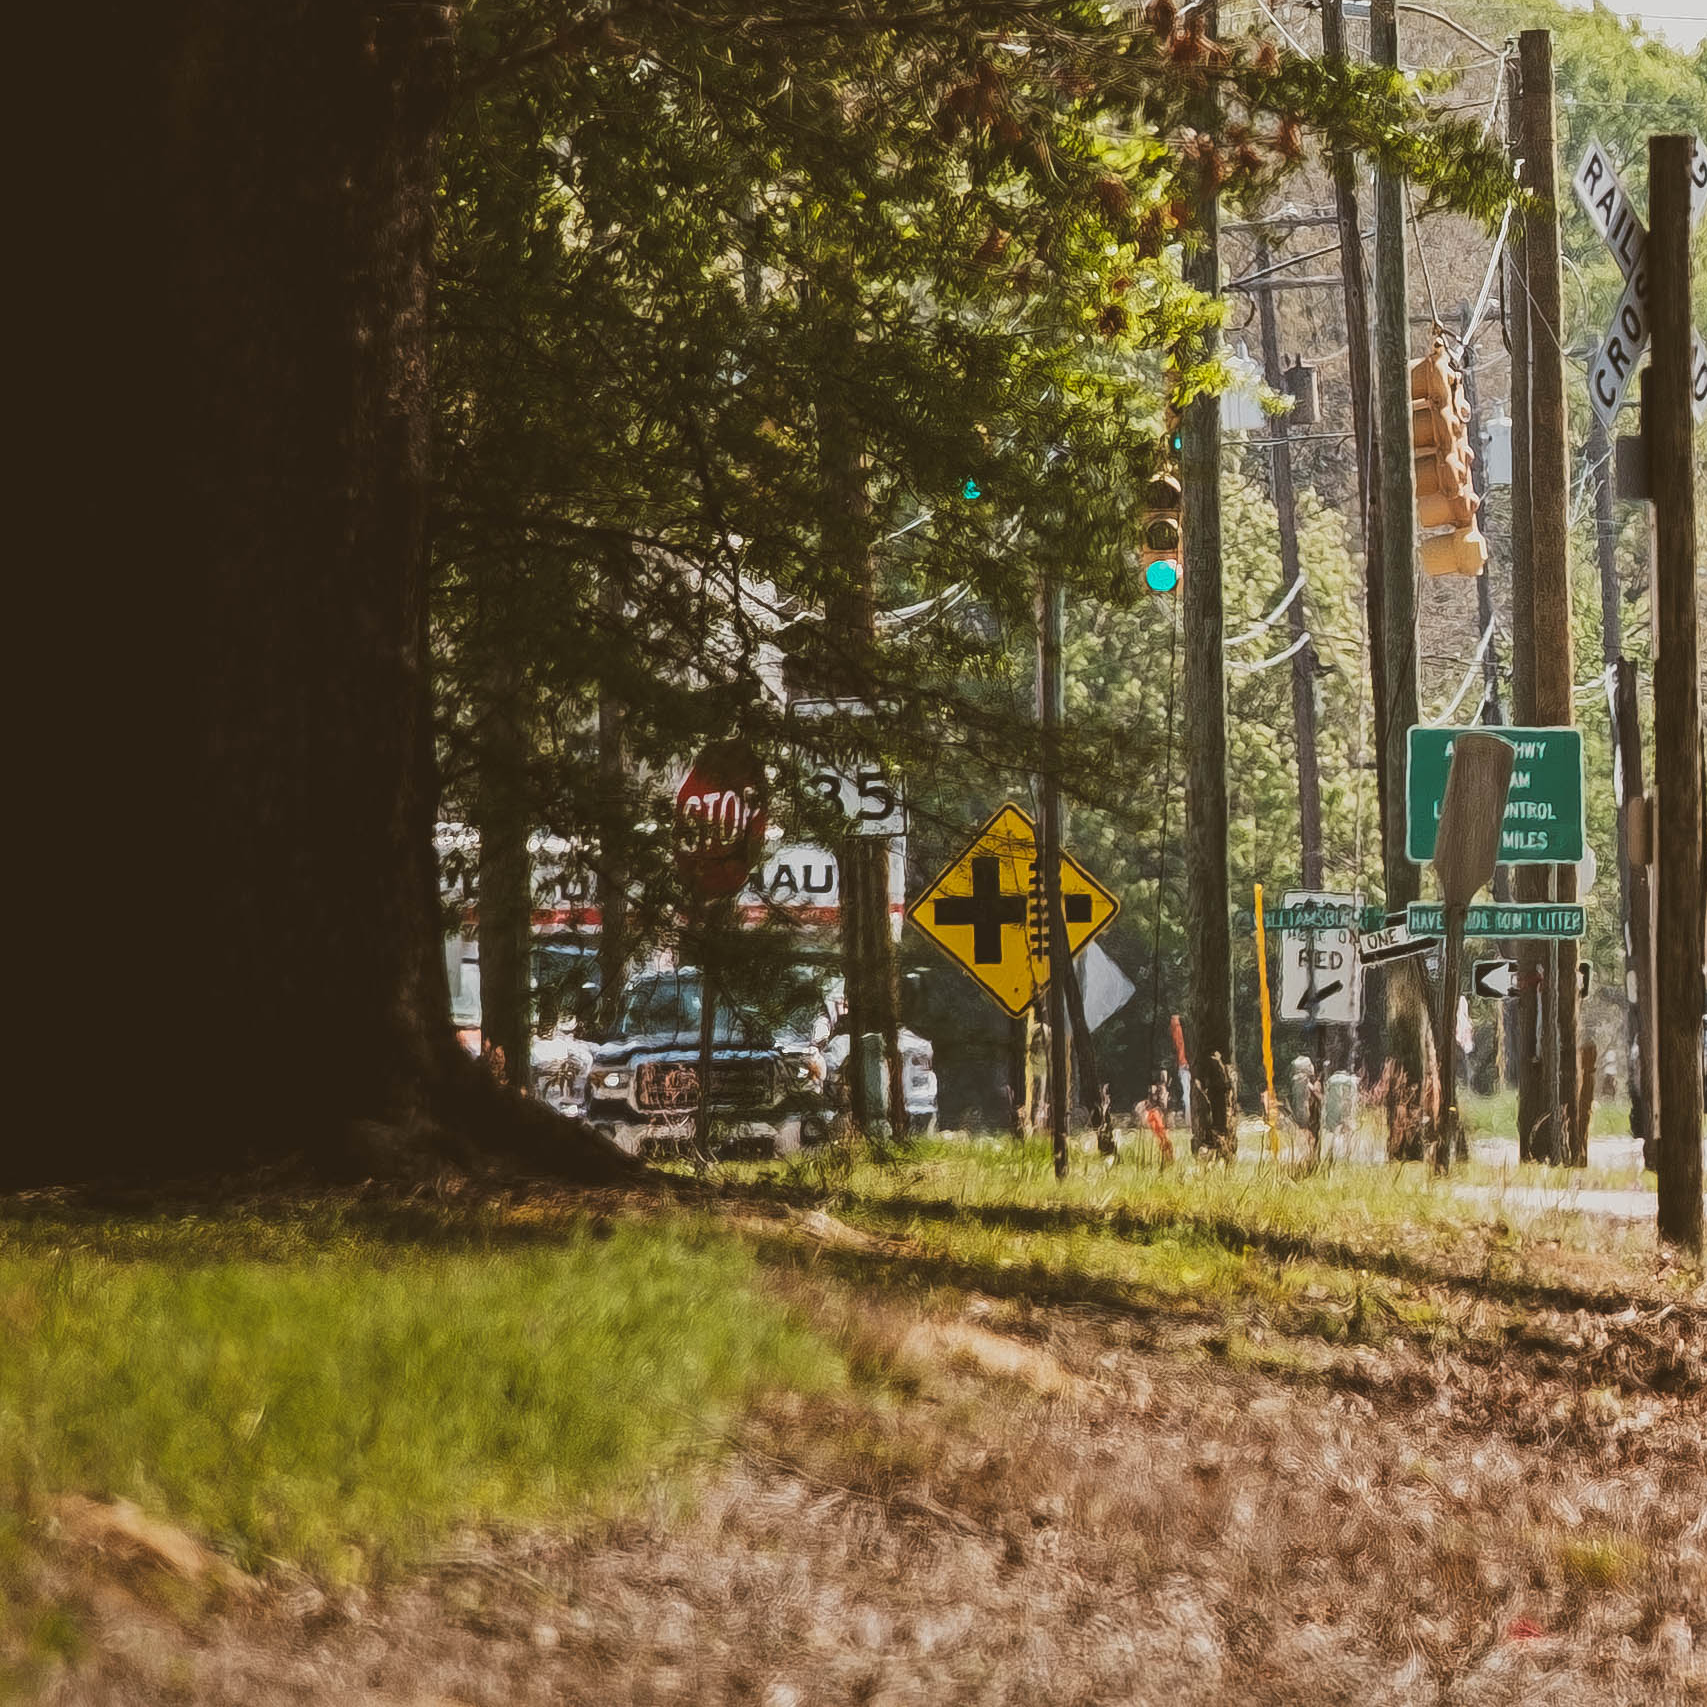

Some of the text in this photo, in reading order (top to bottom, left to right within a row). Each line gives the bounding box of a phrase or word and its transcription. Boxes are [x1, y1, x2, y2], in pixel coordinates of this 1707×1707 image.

[1502, 831, 1549, 851] MILES
[1411, 910, 1444, 931] HAVE
[1537, 910, 1582, 930] LITTER
[1367, 928, 1398, 949] ONE
[1298, 948, 1344, 970] RED
